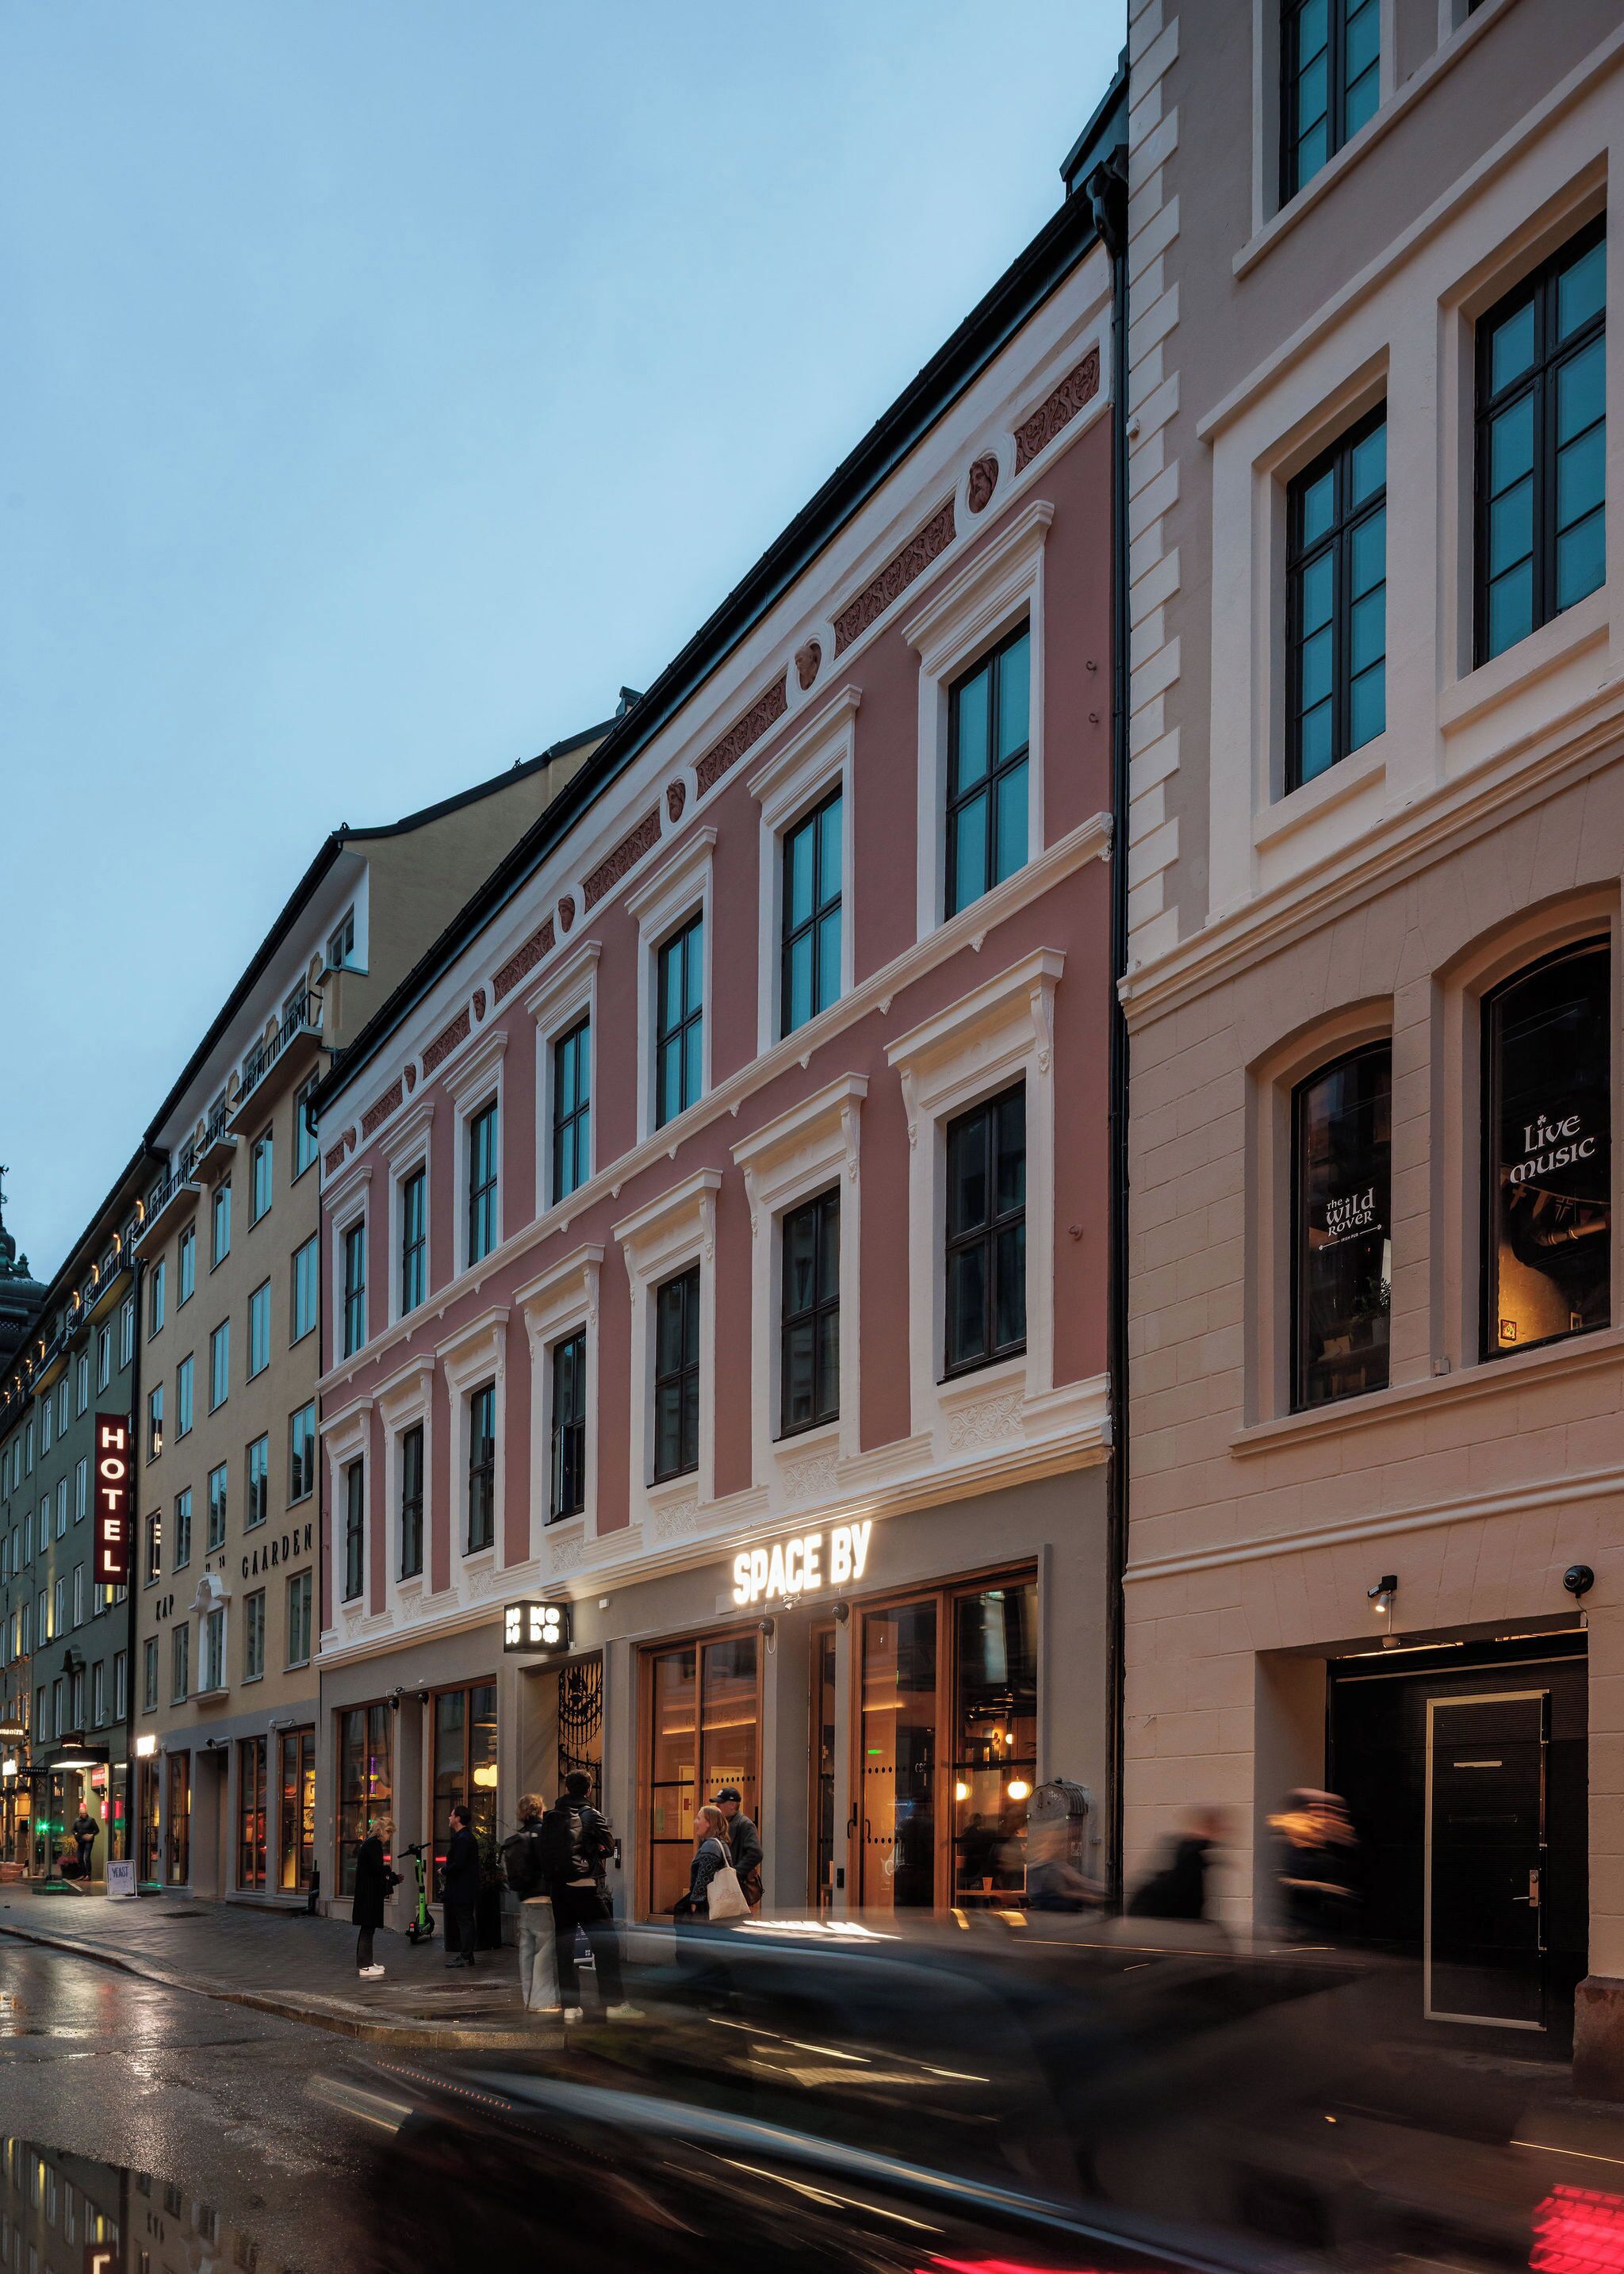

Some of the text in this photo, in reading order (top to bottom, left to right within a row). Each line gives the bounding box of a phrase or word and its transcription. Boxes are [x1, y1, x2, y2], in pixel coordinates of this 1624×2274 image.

[100, 1426, 125, 1572] HOTEL
[242, 1523, 312, 1579] GAARDEN
[733, 1533, 822, 1605] SPACE
[155, 1594, 174, 1621] KAP
[112, 1866, 129, 1878] YEAST
